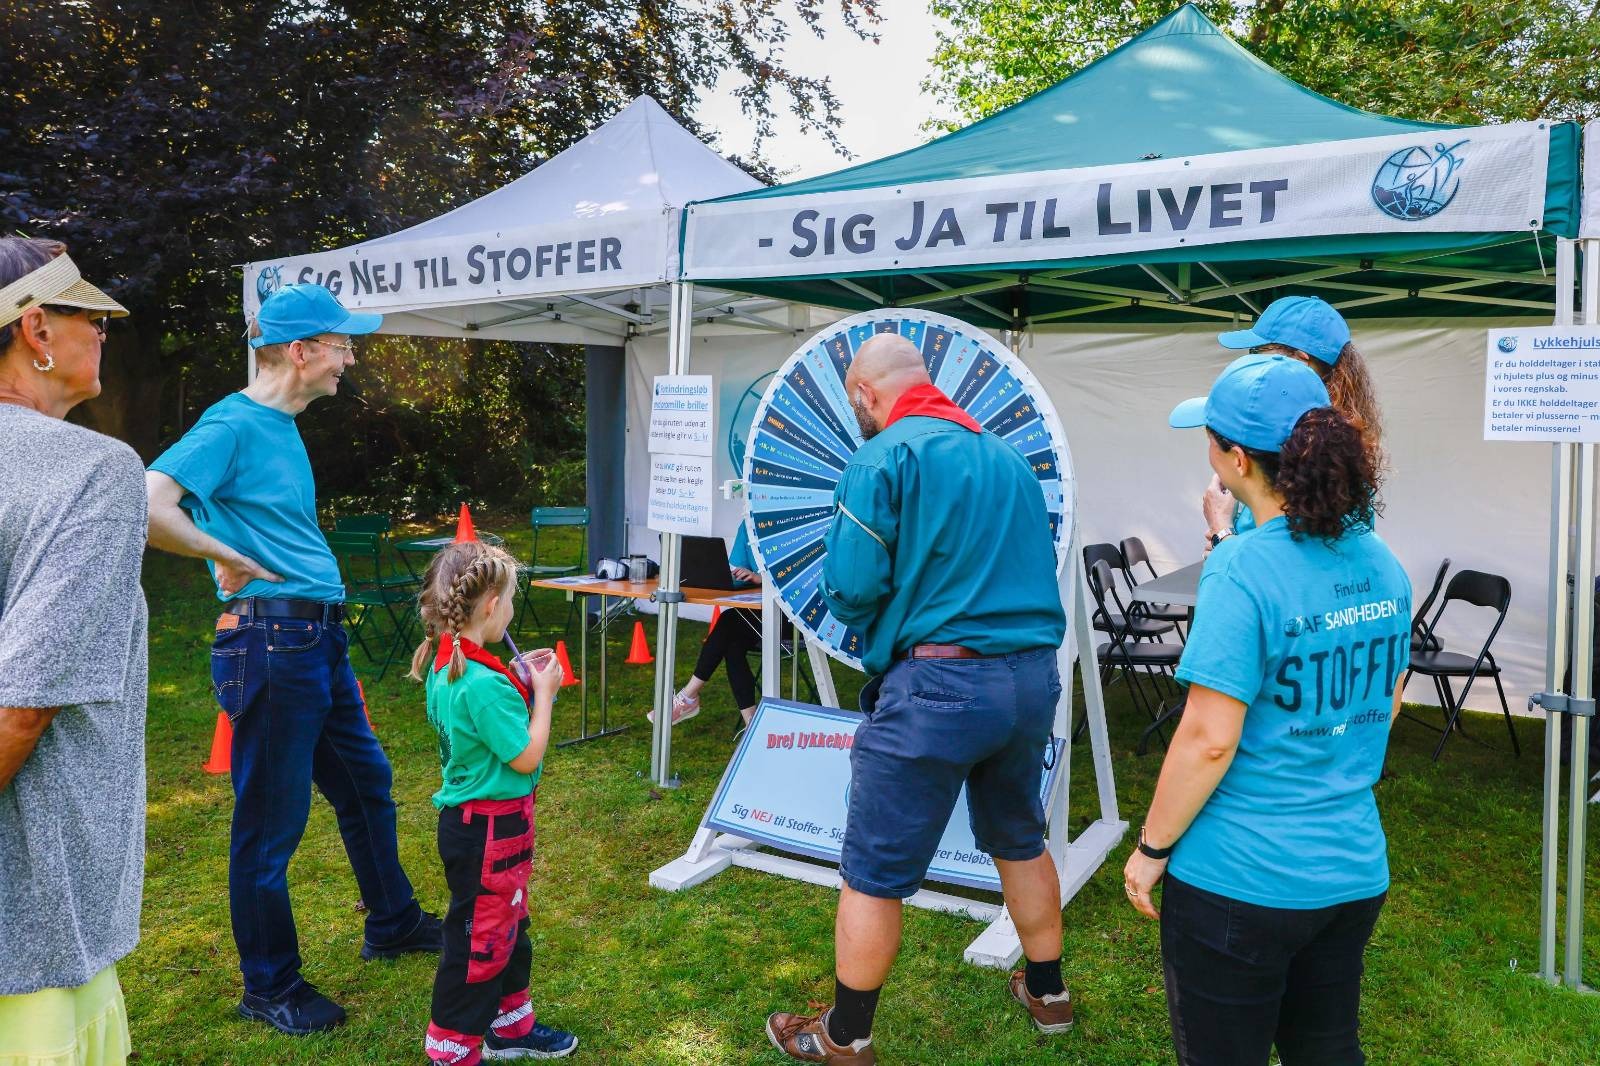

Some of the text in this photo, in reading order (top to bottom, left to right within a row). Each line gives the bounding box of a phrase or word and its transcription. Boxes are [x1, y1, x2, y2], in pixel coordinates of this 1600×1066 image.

[1495, 360, 1504, 368] Er
[1505, 359, 1517, 368] du
[1519, 359, 1577, 369] holddeltager
[1503, 372, 1534, 381] hjulets
[1535, 373, 1555, 381] plus
[1556, 374, 1568, 382] og
[1570, 372, 1599, 380] minus
[1524, 384, 1568, 394] regnskab.
[1492, 398, 1598, 409] Er du IKKE holddeltager
[1492, 411, 1524, 419] betaler
[1526, 411, 1534, 419] vi
[1535, 411, 1580, 421] plusserne
[1491, 424, 1581, 433] betaler minusserne!
[1357, 577, 1371, 593] ud
[1303, 614, 1322, 634] AF
[1325, 599, 1398, 630] SANDHEDEN
[767, 732, 795, 750] Drej
[731, 803, 749, 820] Sig
[750, 808, 773, 823] NEJ
[773, 815, 786, 827] til
[786, 818, 822, 836] Stoffer
